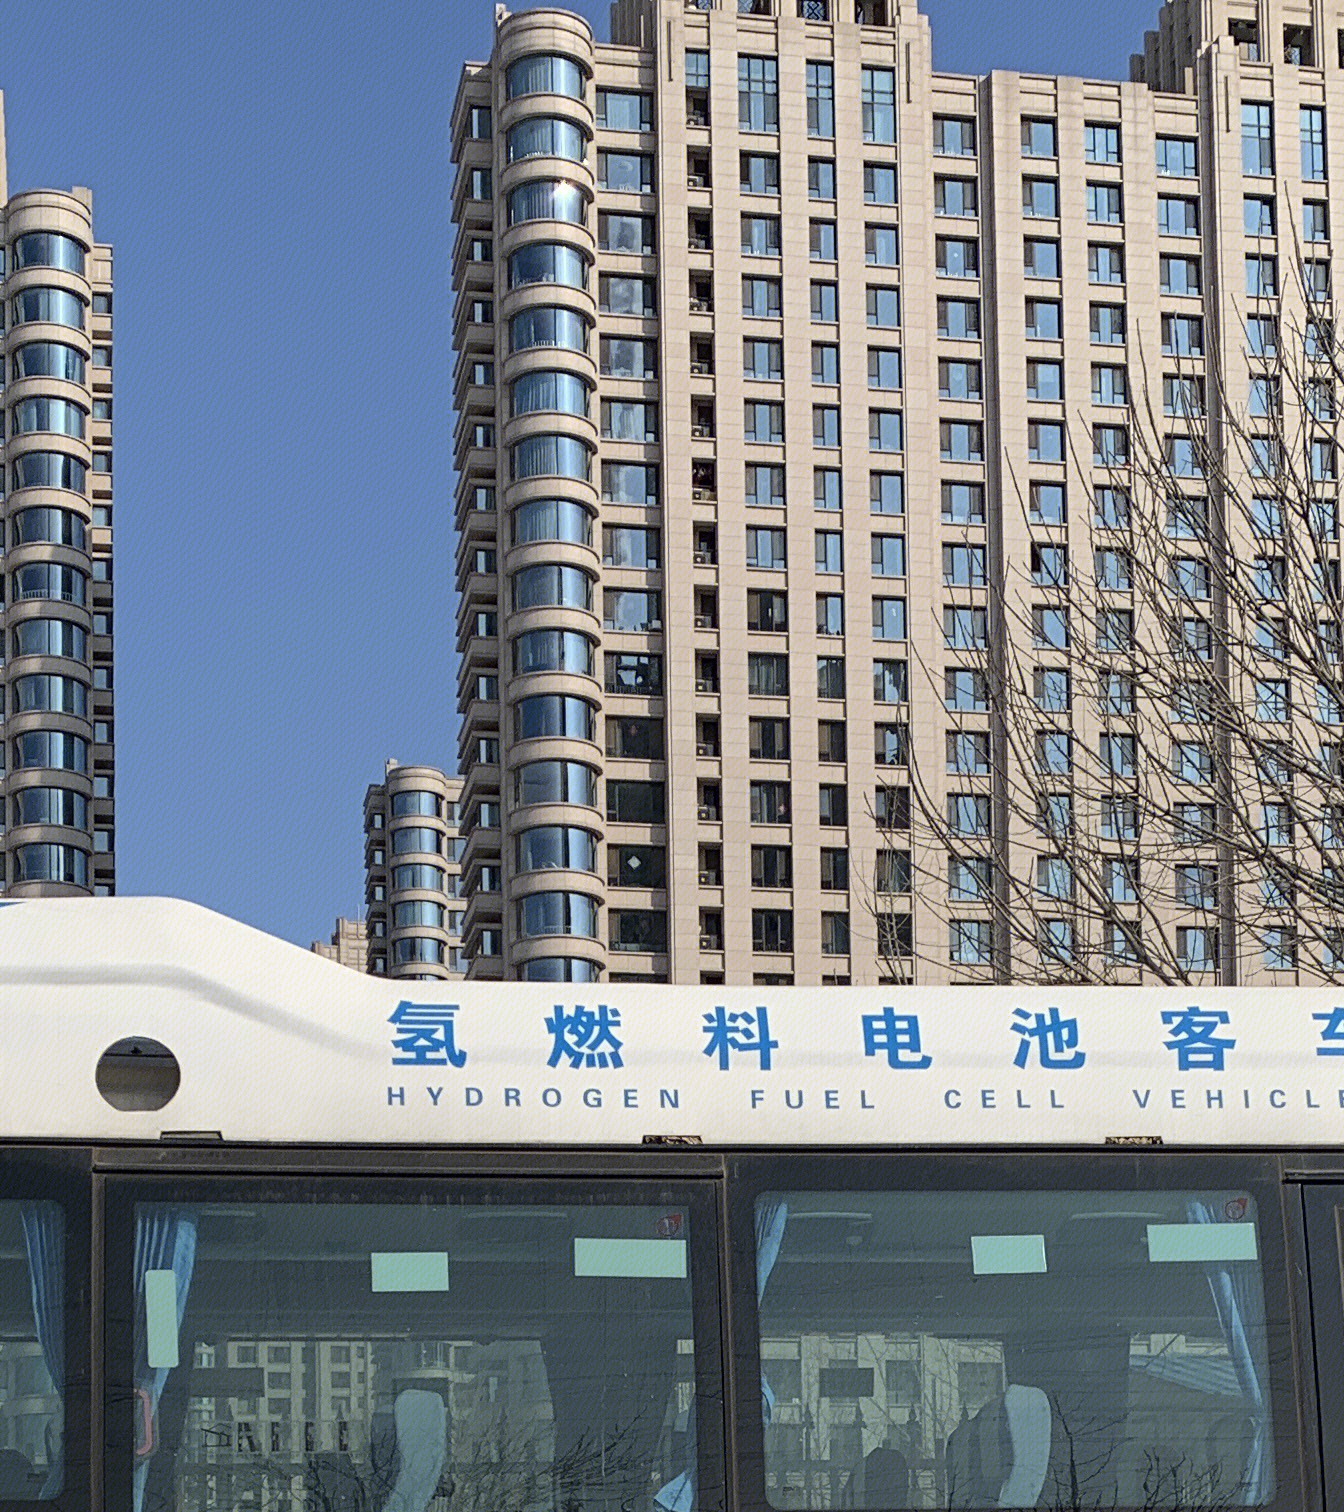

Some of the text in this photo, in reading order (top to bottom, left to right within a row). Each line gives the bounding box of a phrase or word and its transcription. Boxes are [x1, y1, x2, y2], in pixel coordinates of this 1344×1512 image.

[387, 1087, 680, 1109] HYDROGEN
[750, 1089, 876, 1110] FUEL
[944, 1089, 1067, 1110] CELL
